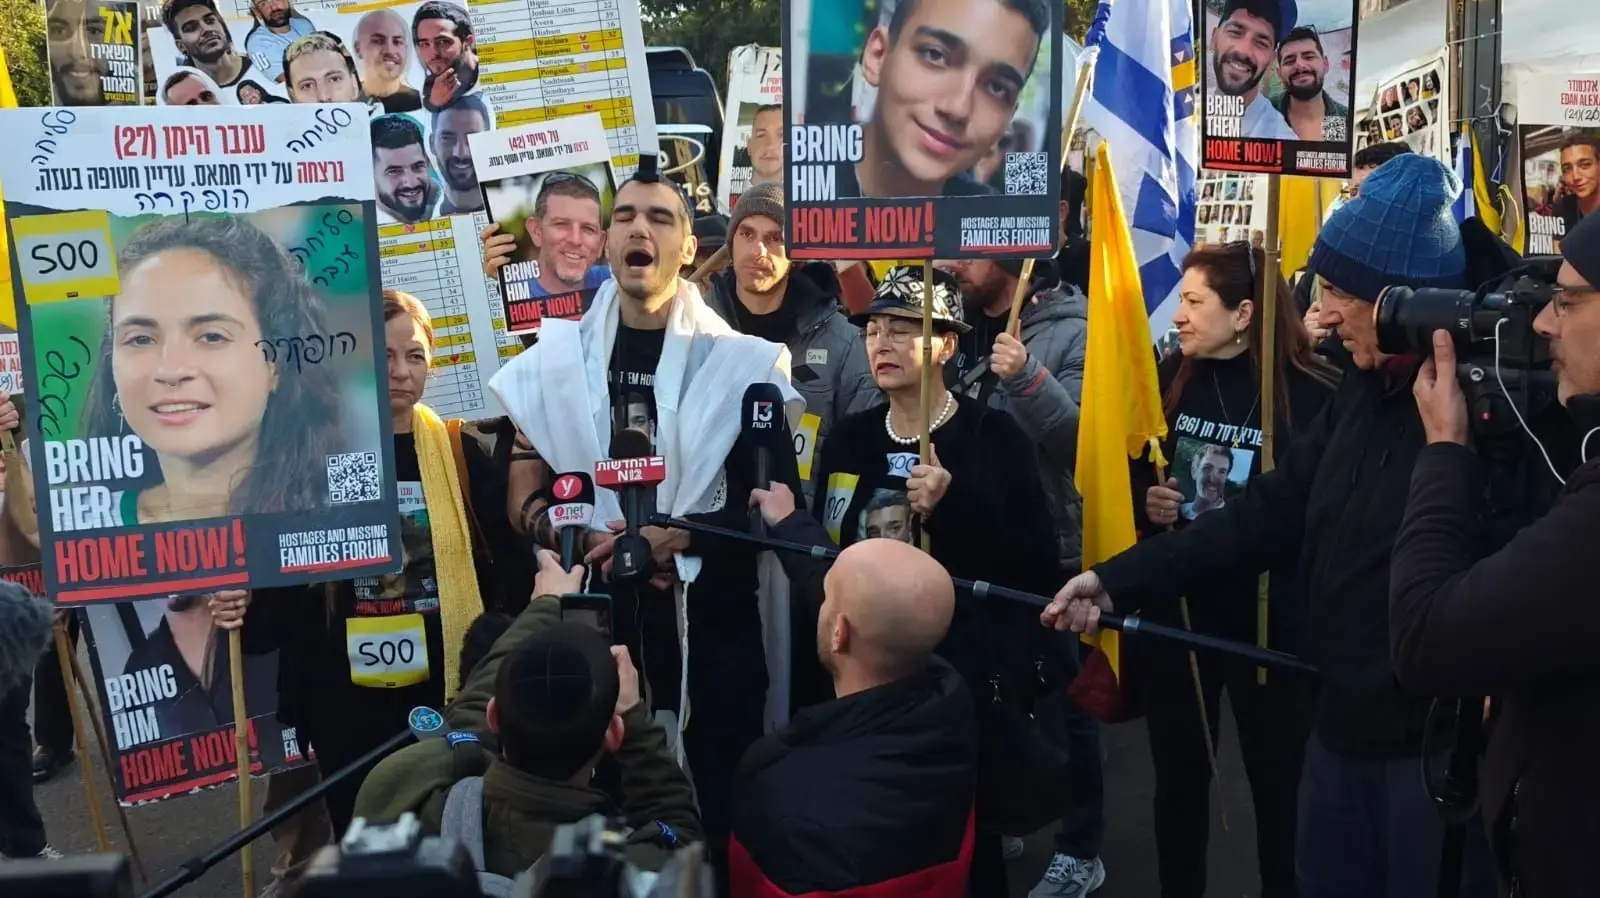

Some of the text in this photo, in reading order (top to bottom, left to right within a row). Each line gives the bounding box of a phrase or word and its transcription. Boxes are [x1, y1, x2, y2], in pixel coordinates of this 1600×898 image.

[98, 6, 134, 45] אל
[532, 9, 554, 17] Joshua
[90, 43, 134, 61] תשאירו
[108, 60, 134, 77] אותי
[100, 76, 135, 94] מאחור
[1206, 95, 1245, 116] BRING
[1560, 93, 1600, 107] EDAN ALEX
[31, 109, 77, 166] סליחה
[286, 107, 353, 154] סליחה
[1206, 117, 1241, 137] THEM
[114, 124, 266, 159] ענבר הימן (27)
[508, 135, 526, 152] (42)
[791, 124, 864, 163] BRING
[1205, 139, 1282, 166] HOME NOW!
[35, 160, 345, 192] נרצחה על ידי חמאס. עדיין חטופה בעזה.
[1296, 158, 1347, 170] FAMILIES FORUM
[791, 165, 837, 201] HIM
[134, 189, 250, 225] הופקרה
[791, 201, 936, 244] HOME NOW!
[960, 216, 1050, 230] HOSTAGES AND MISSING
[1528, 214, 1566, 237] BRING
[960, 229, 1050, 247] FAMILIES FORUM
[1528, 235, 1554, 255] HIM
[31, 240, 99, 275] 500
[502, 260, 540, 282] BRING
[506, 281, 530, 302] HIM
[509, 291, 583, 323] HOME NOW!
[254, 331, 357, 374] הופקרה
[752, 421, 772, 429] רשת
[1175, 412, 1201, 436] (36)
[44, 433, 145, 485] BRING
[596, 457, 648, 472] החדשות
[48, 486, 114, 533] HER
[278, 523, 388, 548] HOSTAGES AND MISSING
[55, 518, 246, 584] HOME NOW!
[280, 537, 389, 568] FAMILIES FORUM
[358, 638, 415, 667] 500
[104, 663, 178, 713] BRING
[114, 706, 161, 751] HIM
[120, 740, 189, 790] HOME
